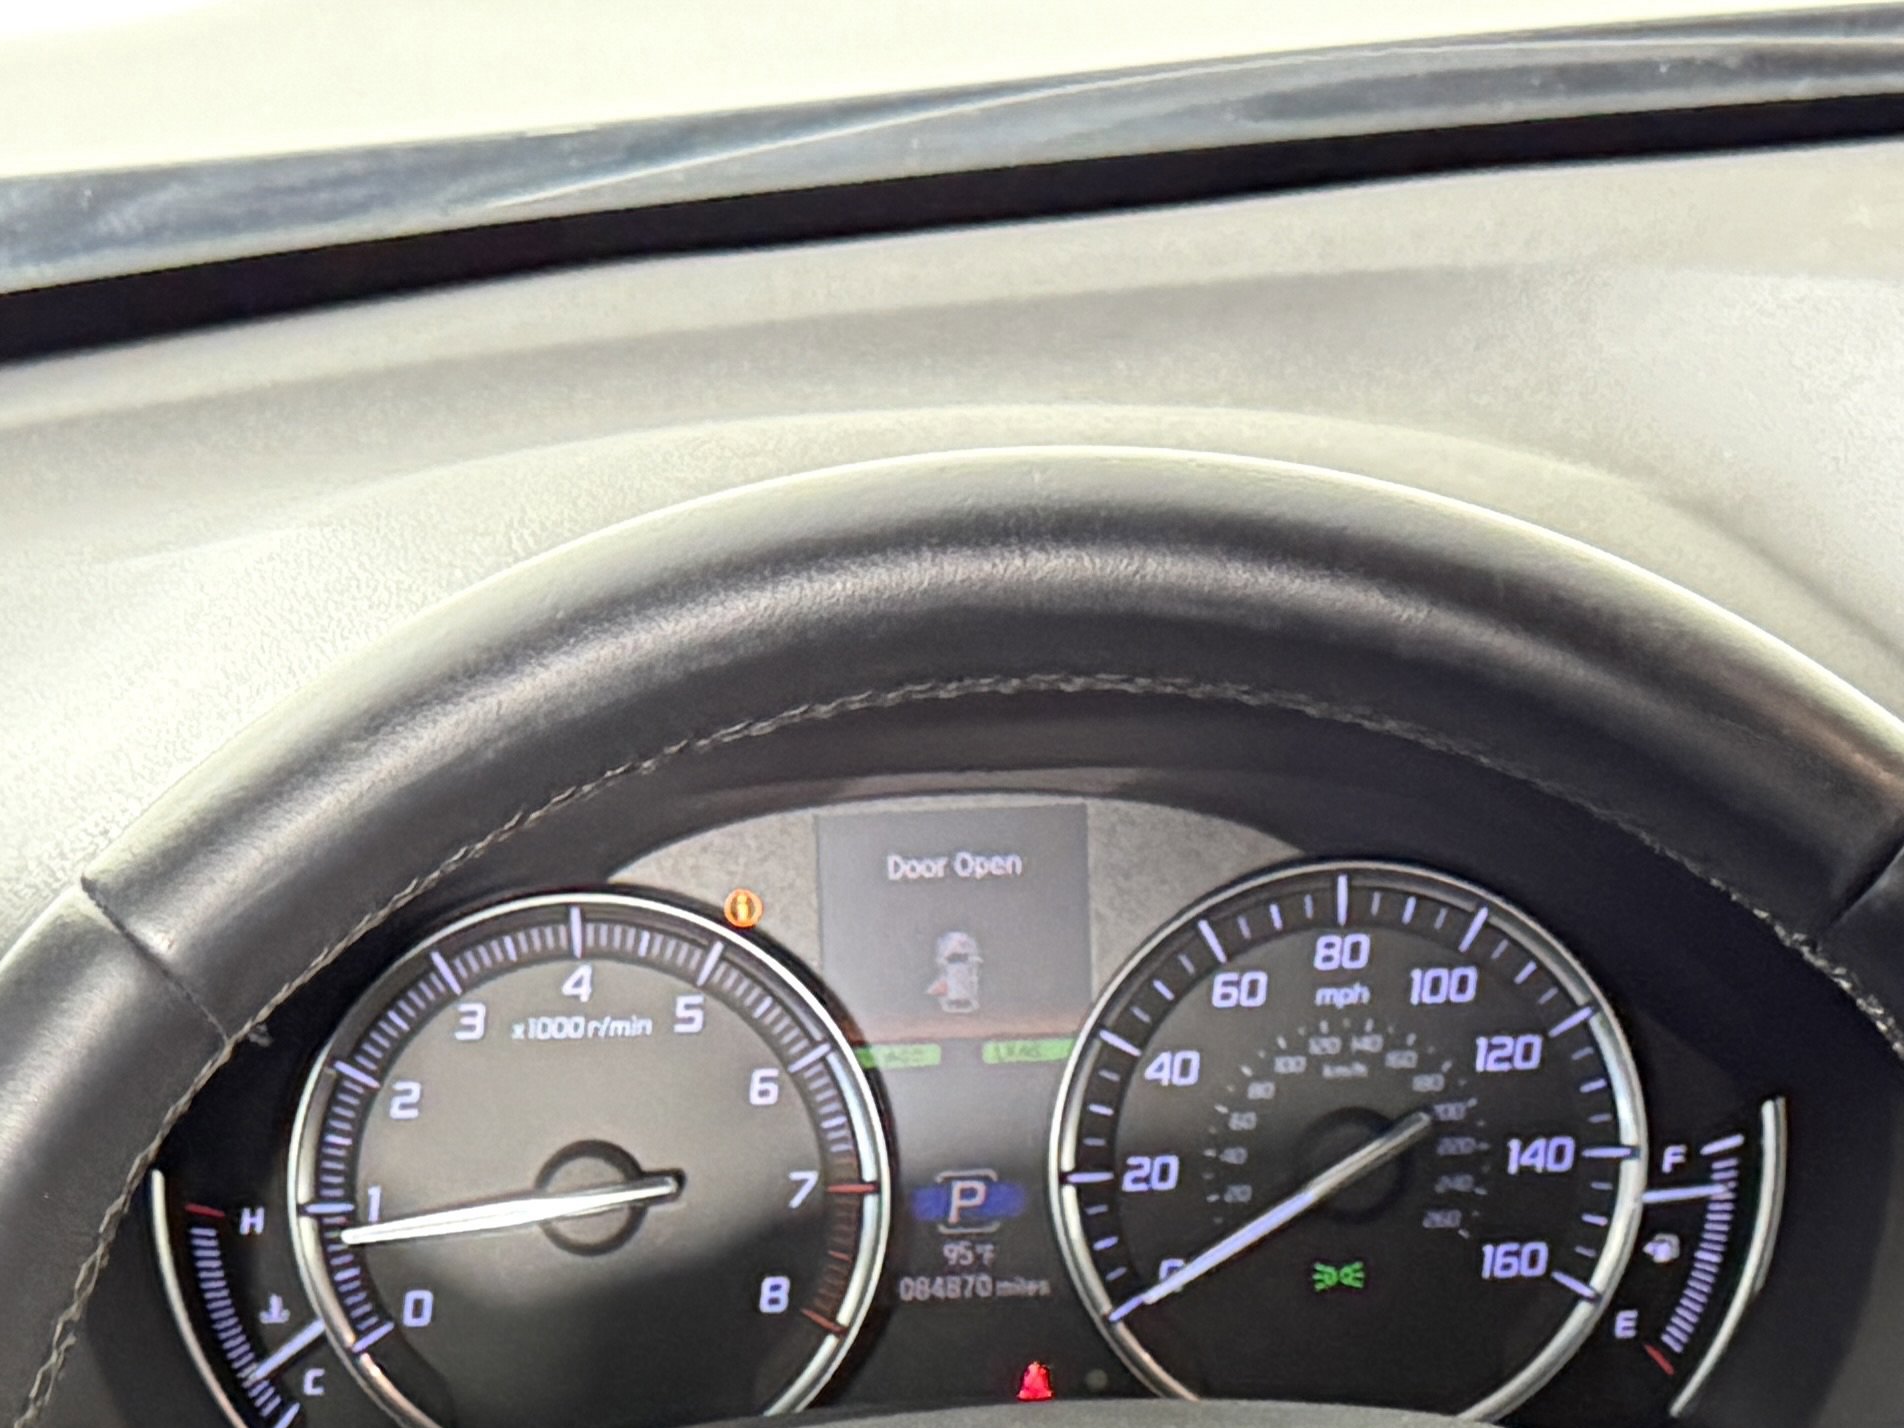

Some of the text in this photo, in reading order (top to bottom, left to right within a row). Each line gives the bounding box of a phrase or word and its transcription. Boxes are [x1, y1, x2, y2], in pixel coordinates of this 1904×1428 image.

[887, 849, 1023, 881] Door Open
[1313, 934, 1370, 970] 80
[561, 965, 592, 1003] 4
[1212, 971, 1268, 1008] 60
[1315, 982, 1371, 1008] mph
[1410, 967, 1477, 1005] 100
[455, 1002, 486, 1040] 3
[511, 1013, 653, 1040] x1000 r/min
[674, 995, 704, 1033] 5
[1145, 1051, 1199, 1085] 40
[1475, 1035, 1542, 1072] 120
[391, 1082, 422, 1119] 2
[749, 1068, 780, 1105] 6
[1122, 1156, 1178, 1192] 20
[1507, 1137, 1575, 1175] 140
[1661, 1145, 1687, 1172] F
[366, 1187, 383, 1222] 1
[788, 1171, 819, 1209] 7
[949, 1180, 987, 1223] P
[240, 1207, 265, 1234] H
[1482, 1241, 1549, 1279] 160
[758, 1276, 791, 1314] 8
[899, 1273, 1051, 1301] 084870 miles
[403, 1290, 434, 1327] 0
[1614, 1310, 1638, 1339] E
[303, 1368, 325, 1396] C
